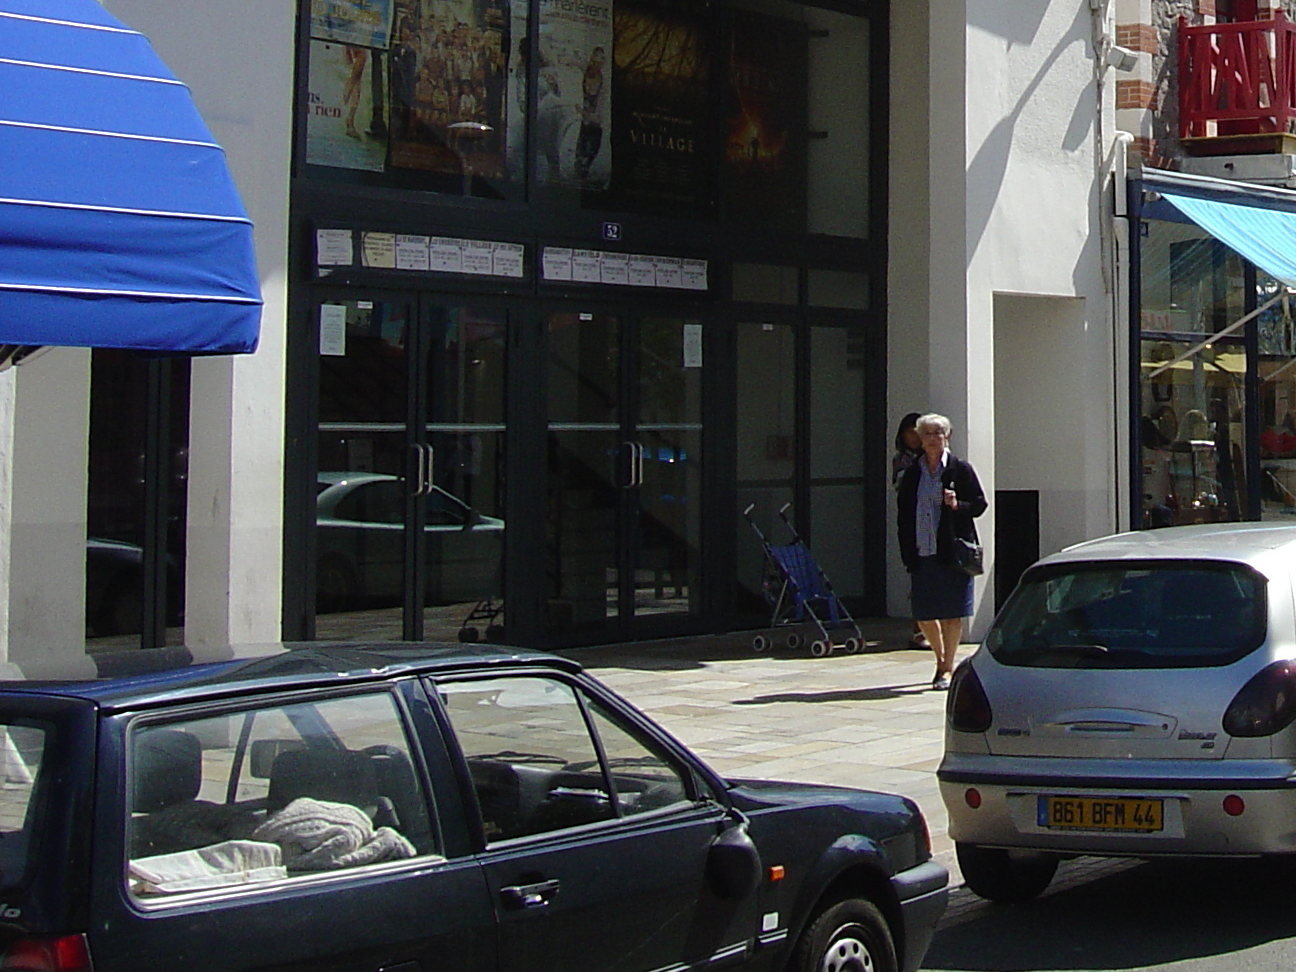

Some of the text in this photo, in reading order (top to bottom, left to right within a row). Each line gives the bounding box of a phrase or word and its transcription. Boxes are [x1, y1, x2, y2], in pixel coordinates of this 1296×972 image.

[630, 129, 695, 152] VILLAGE
[607, 224, 618, 238] 52
[1052, 801, 1155, 826] 861 BFM 44
